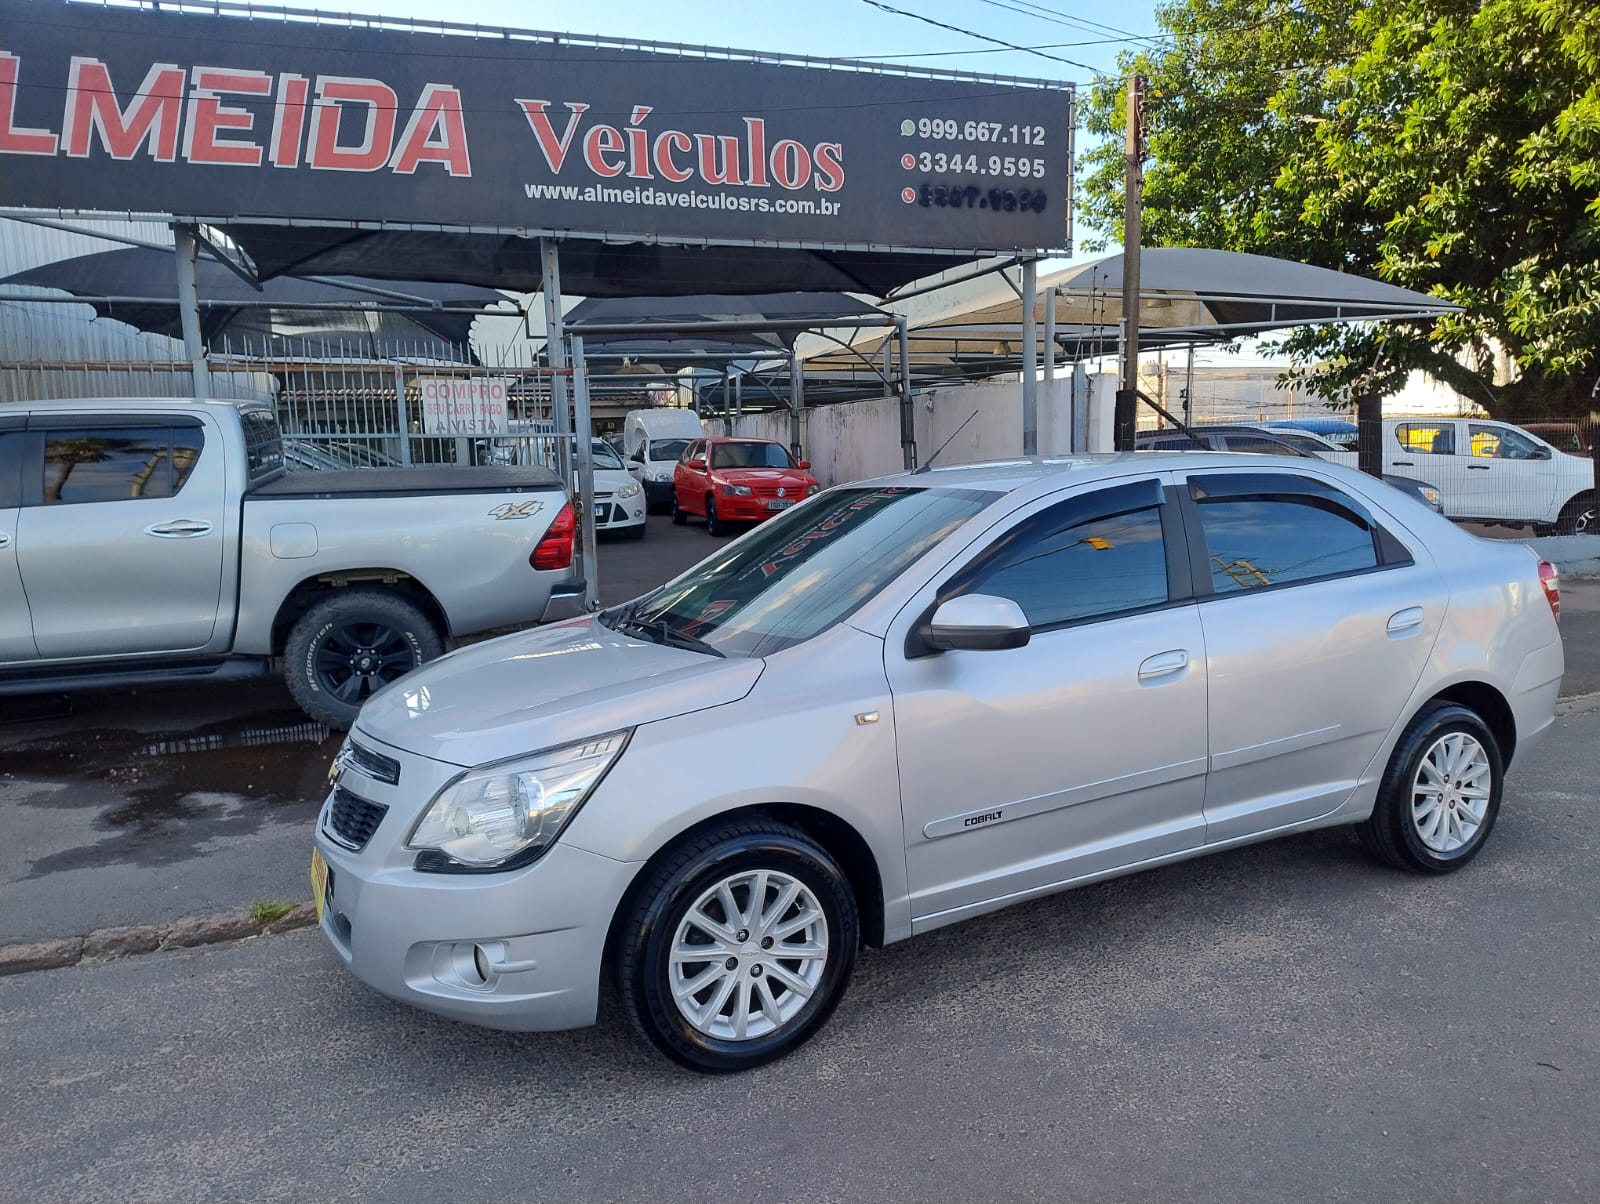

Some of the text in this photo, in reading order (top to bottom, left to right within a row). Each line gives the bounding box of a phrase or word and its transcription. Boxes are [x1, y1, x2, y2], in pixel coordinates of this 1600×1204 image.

[918, 117, 1046, 146] 999.667.112
[514, 97, 846, 193] Veículos
[918, 151, 1046, 178] 3344.9595
[524, 183, 842, 216] www.almeidaveiculosrs.com.br
[425, 383, 503, 400] COMPRO
[427, 402, 445, 416] SEU
[479, 402, 503, 416] PAGO
[451, 419, 498, 432] VISTA
[964, 810, 1003, 827] COBALT
